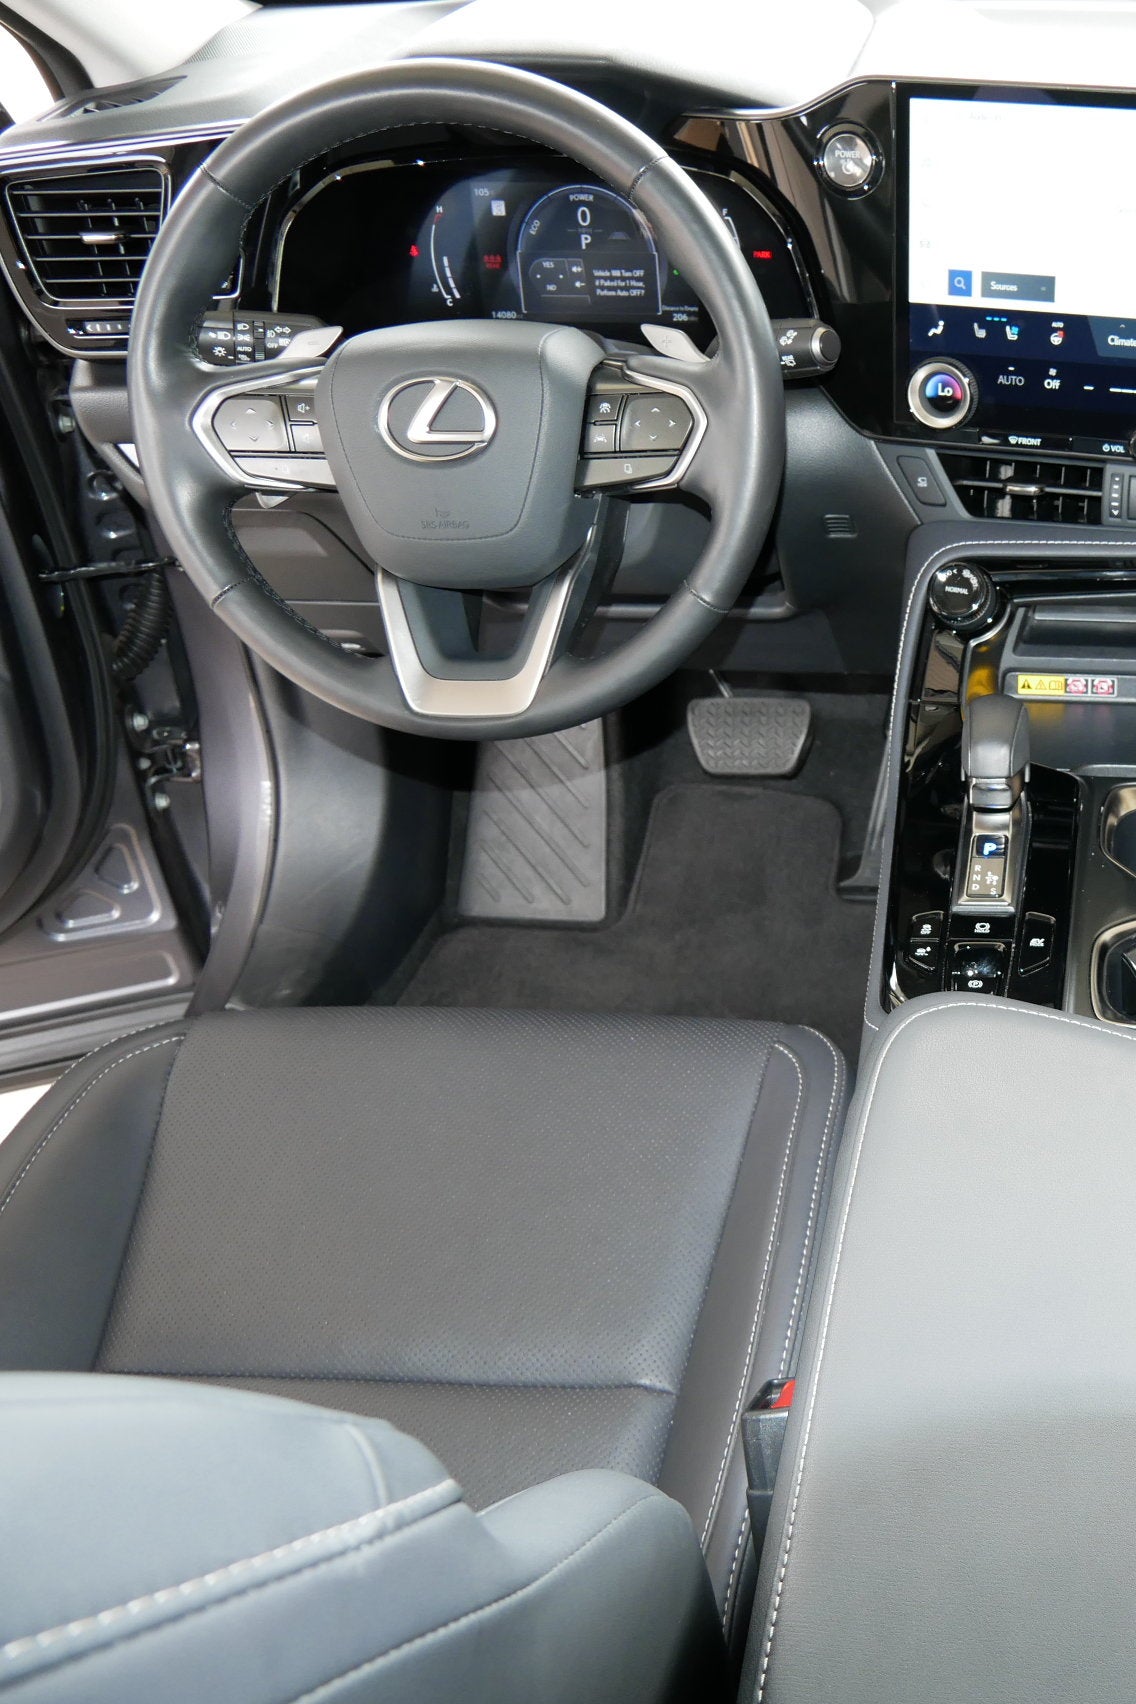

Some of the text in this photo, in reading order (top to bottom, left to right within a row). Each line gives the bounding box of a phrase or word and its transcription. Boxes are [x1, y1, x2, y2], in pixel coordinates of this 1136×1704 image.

[834, 149, 861, 158] POWER
[569, 194, 594, 202] POWER
[436, 205, 443, 213] H
[722, 208, 728, 216] F
[529, 219, 541, 235] ECO
[580, 234, 592, 250] P
[542, 261, 555, 269] YES
[632, 269, 645, 277] OFF
[990, 281, 1018, 292] Sources
[446, 299, 454, 307] C
[672, 313, 689, 321] 206
[997, 374, 1025, 386] AUTO
[1044, 378, 1061, 390] Off
[937, 382, 954, 397] Lo
[1018, 437, 1042, 446] FRONT
[1110, 445, 1126, 453] VOL
[945, 585, 969, 595] NORMAL
[983, 842, 997, 856] P
[974, 864, 982, 872] R
[971, 883, 980, 891] D
[990, 887, 997, 895] S
